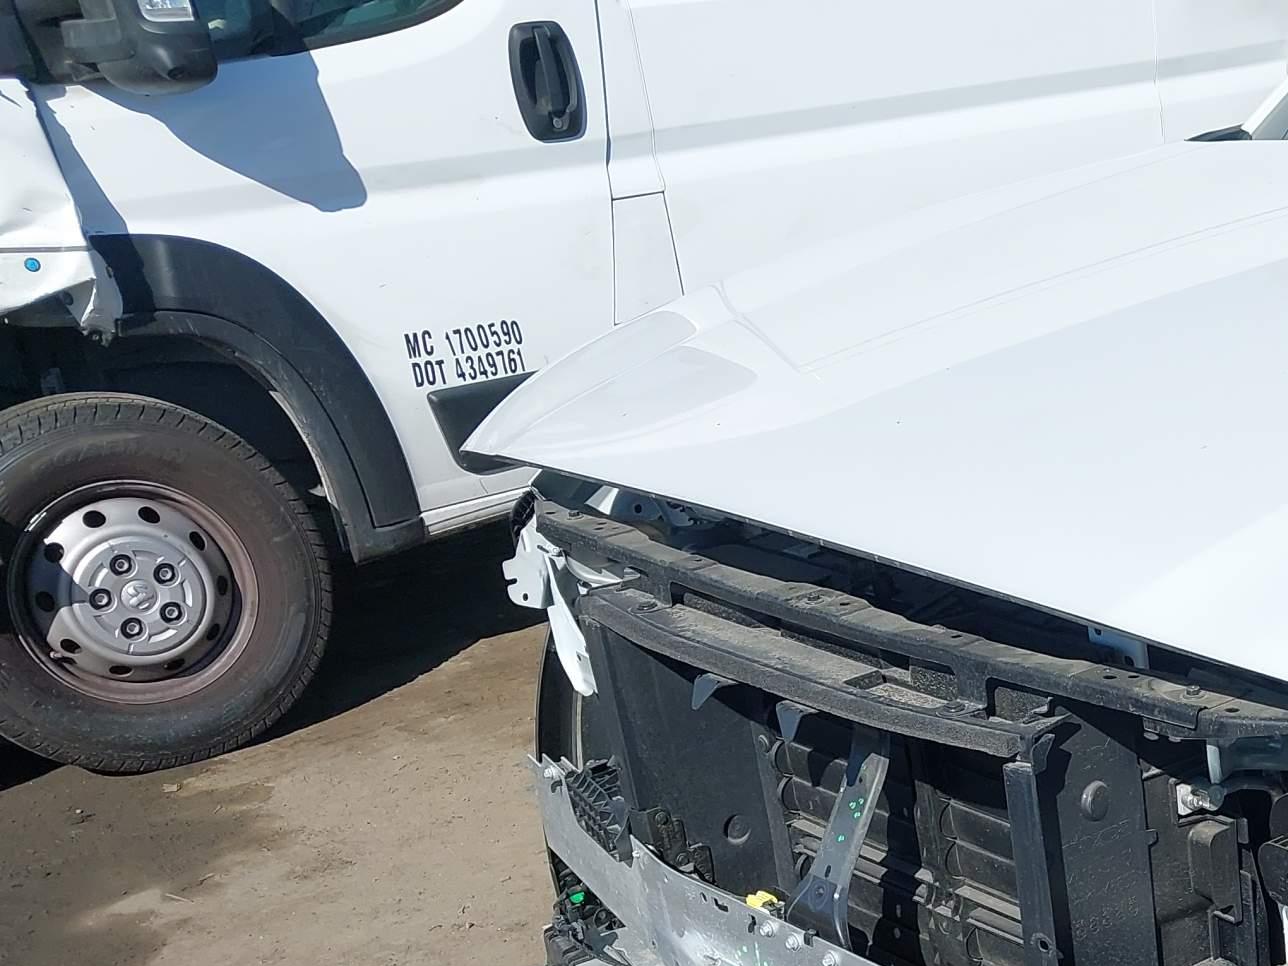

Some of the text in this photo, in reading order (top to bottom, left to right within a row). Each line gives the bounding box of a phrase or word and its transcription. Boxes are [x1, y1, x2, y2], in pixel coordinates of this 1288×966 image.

[404, 320, 523, 359] MC 1700590
[411, 348, 526, 387] DOT 4349761
